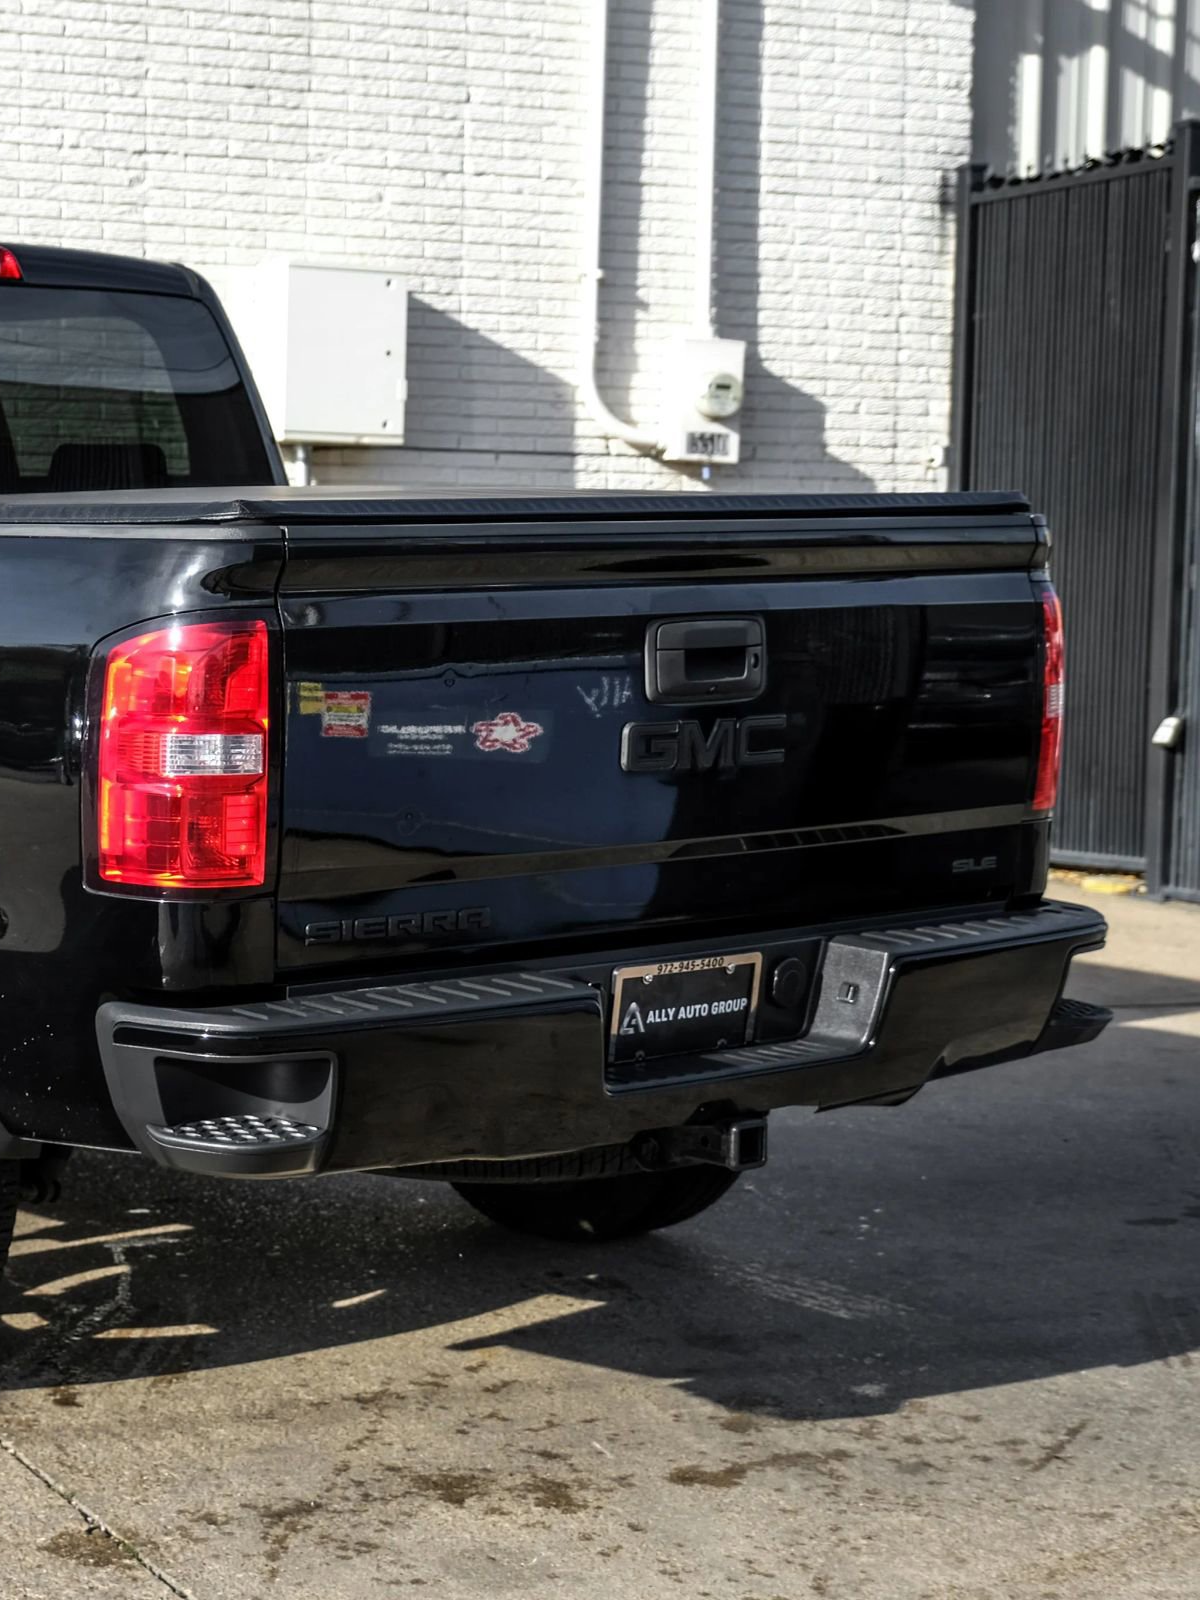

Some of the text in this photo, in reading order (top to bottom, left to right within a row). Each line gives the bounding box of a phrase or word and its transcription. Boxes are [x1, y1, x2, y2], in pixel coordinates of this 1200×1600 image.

[620, 713, 787, 772] GMC
[951, 856, 998, 873] SLE
[304, 906, 491, 947] SIERRA
[656, 957, 725, 975] 972-945-5400
[646, 998, 748, 1024] ALLY AUTO GROUP
